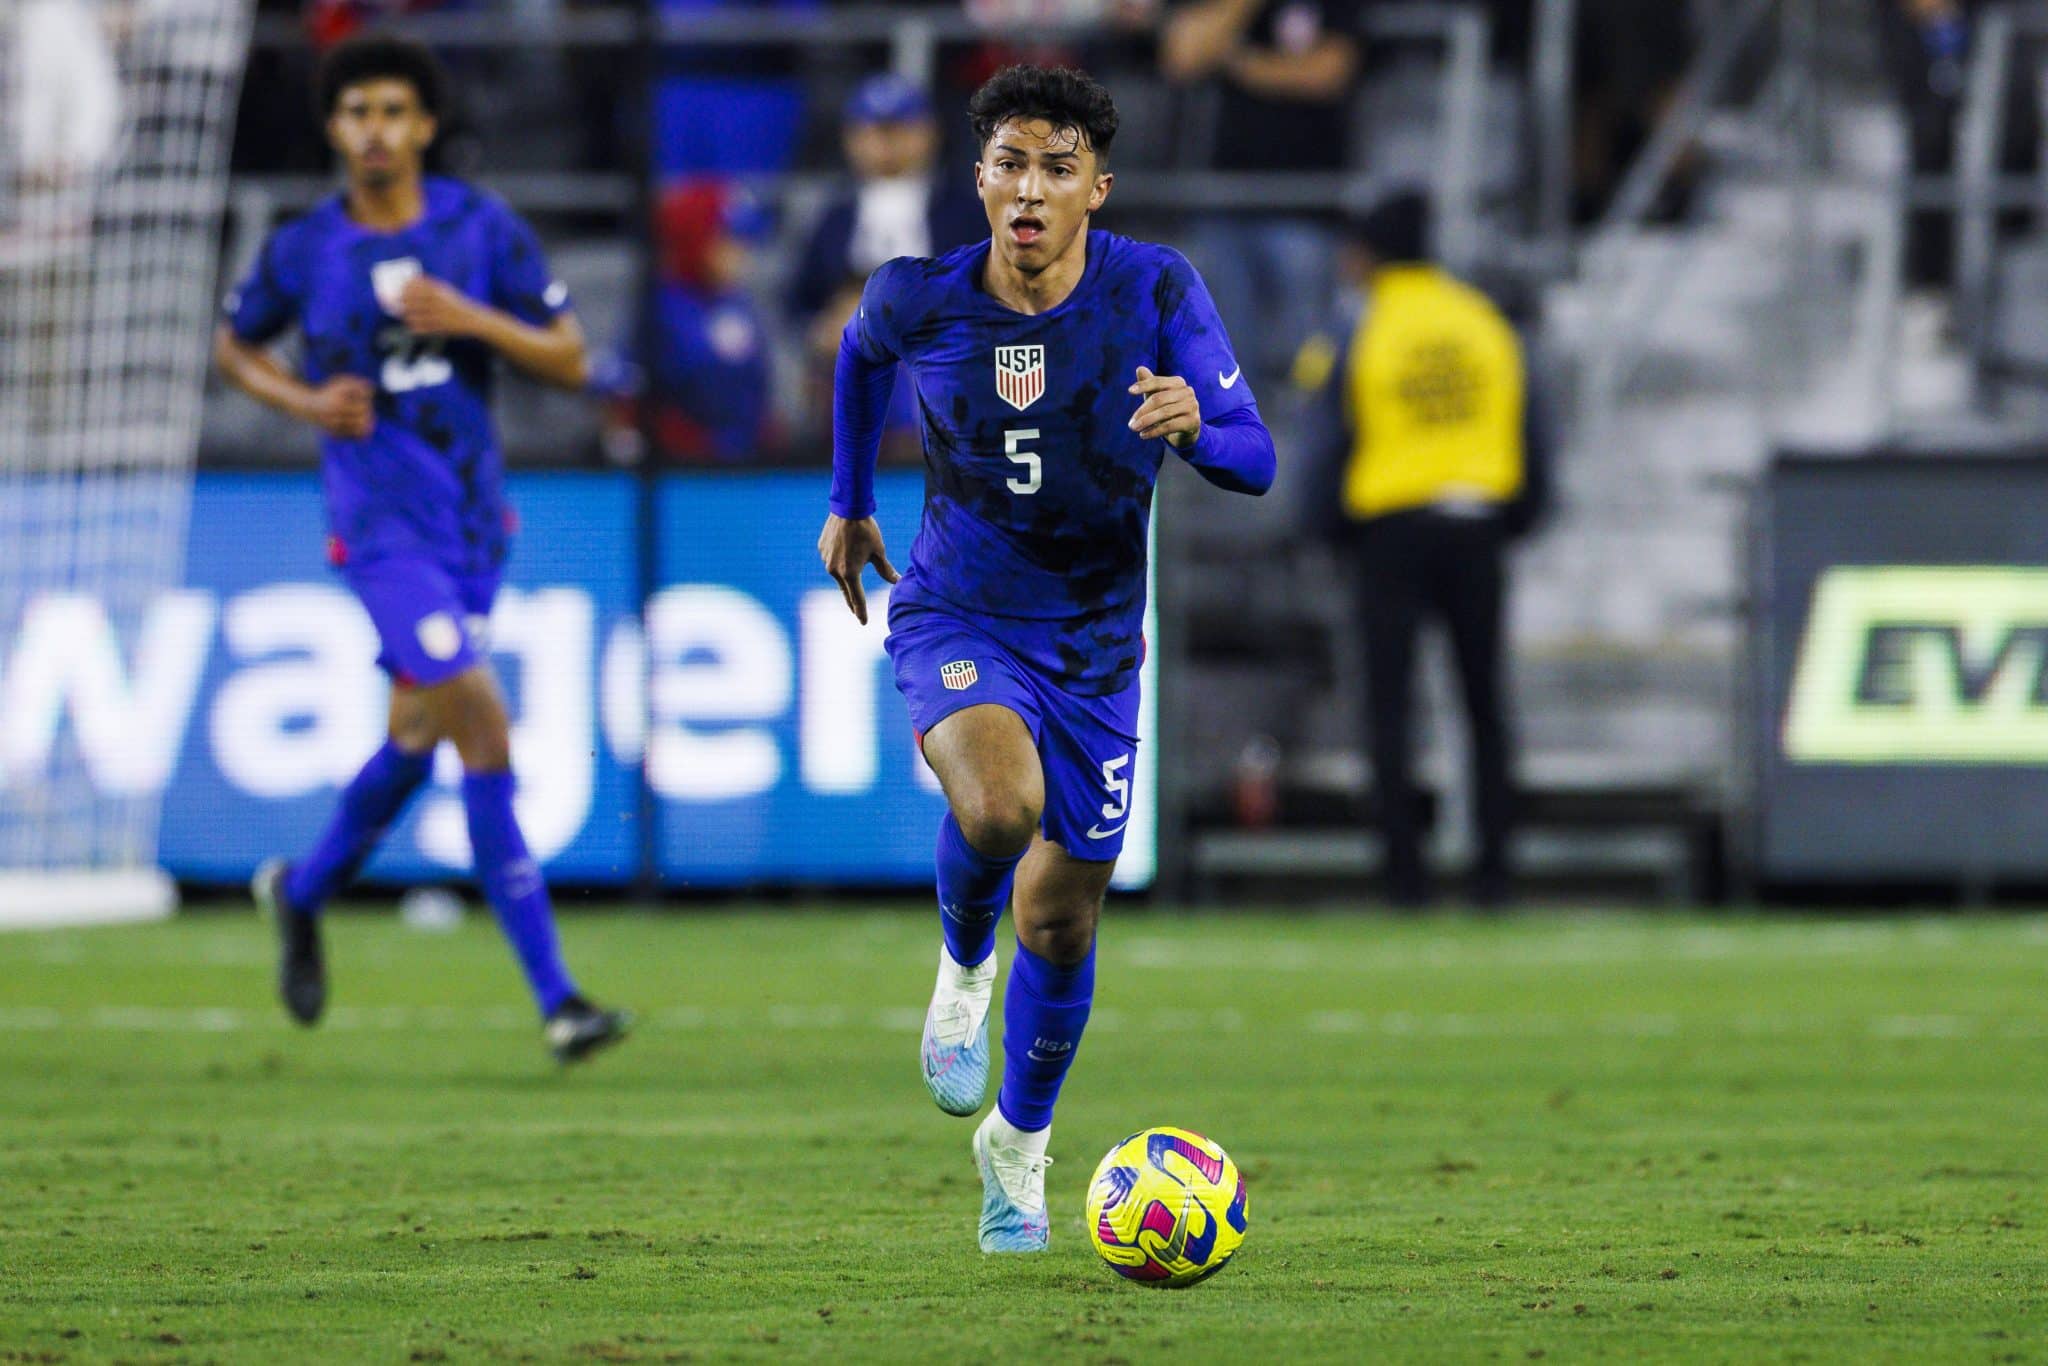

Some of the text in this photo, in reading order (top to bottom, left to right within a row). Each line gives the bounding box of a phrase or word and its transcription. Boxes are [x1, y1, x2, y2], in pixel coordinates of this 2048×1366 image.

[998, 348, 1041, 373] USA
[1004, 428, 1042, 494] 5
[942, 661, 973, 675] USA
[1102, 753, 1129, 819] 5
[1034, 1036, 1071, 1052] USA
